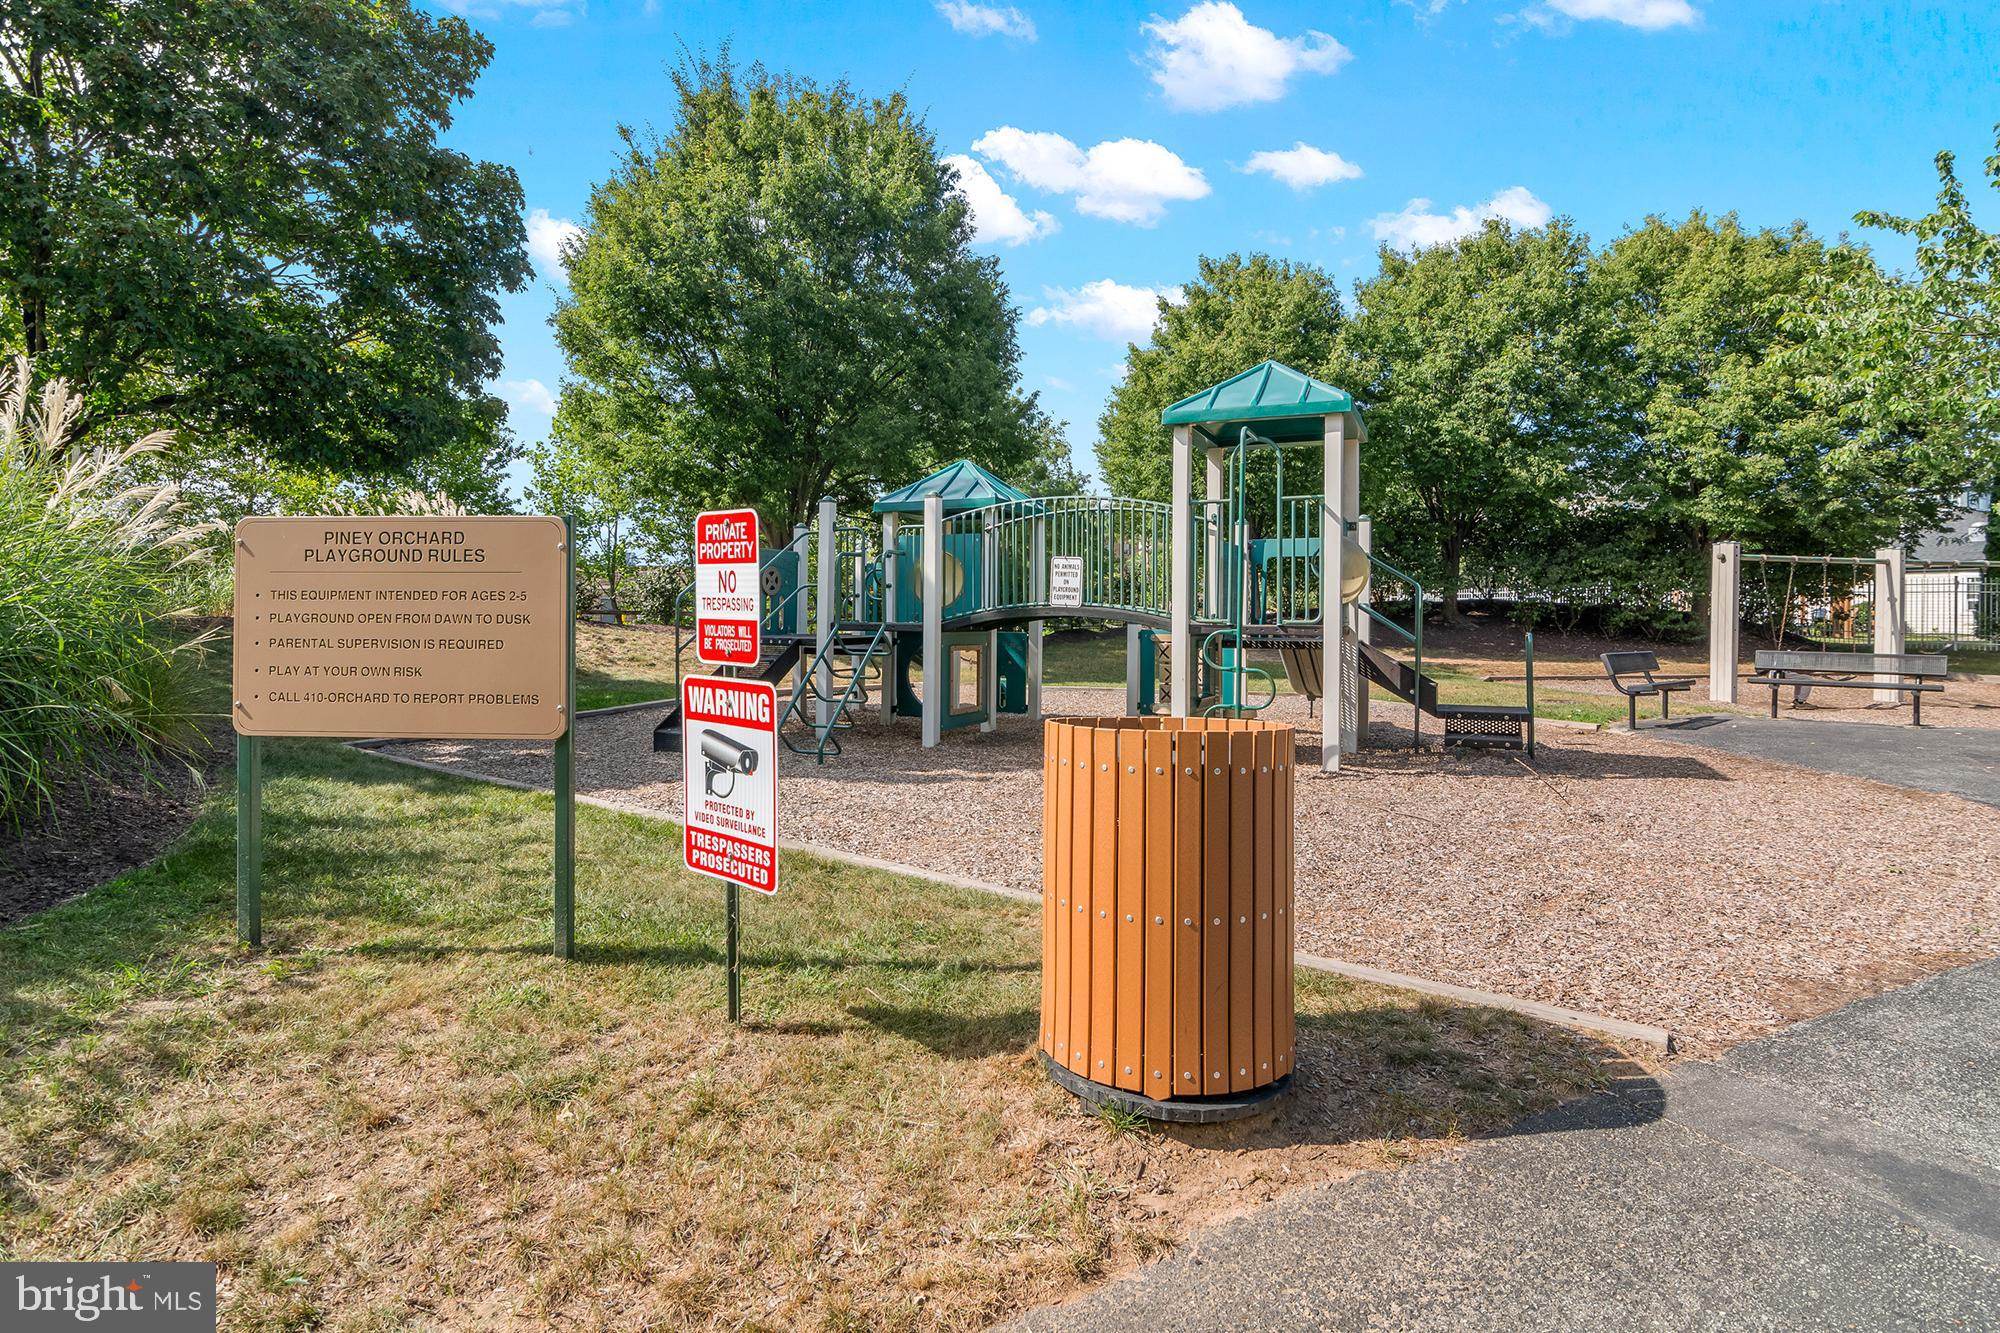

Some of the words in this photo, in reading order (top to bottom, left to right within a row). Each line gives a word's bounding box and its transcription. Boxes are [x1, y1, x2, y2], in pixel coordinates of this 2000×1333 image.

[324, 531, 373, 545] PINEY
[378, 531, 465, 545] ORCHARD
[705, 522, 747, 540] PRIVATE
[304, 549, 422, 563] PLAYGROUND
[428, 549, 485, 563] RULES
[700, 541, 754, 560] PROPERTY
[718, 570, 736, 593] NO
[271, 590, 298, 601] THIS
[301, 590, 372, 601] EQUIPMENT
[375, 590, 438, 601] INTENDED
[442, 591, 467, 601] FOR
[471, 591, 505, 601] AGES
[509, 591, 527, 601] 2-5
[702, 598, 754, 611] TRESPASSING
[269, 613, 355, 624] PLAYGROUND
[357, 613, 392, 624] OPEN
[396, 614, 431, 624] FROM
[434, 614, 472, 624] DAWN
[476, 614, 492, 625] TO
[496, 614, 531, 625] DUSK
[704, 624, 735, 637] VIOLATORS
[738, 626, 752, 638] WILL
[269, 638, 334, 649] PARENTAL
[337, 638, 420, 650] SUPERVISION
[424, 639, 435, 650] IS
[440, 639, 504, 650] REQUIRED
[704, 638, 712, 649] BE
[716, 639, 752, 652] PROSECUTED
[269, 665, 300, 676] PLAY
[304, 666, 319, 676] AT
[323, 666, 358, 677] YOUR
[361, 666, 390, 677] OWN
[394, 666, 422, 677] RISK
[268, 692, 300, 702] CALL
[304, 692, 389, 704] 410-ORCHARD
[393, 693, 410, 704] TO
[413, 693, 465, 704] REPORT
[468, 694, 540, 705] PROBLEMS
[688, 685, 769, 723] WARNING
[705, 800, 743, 818] PROTECTED
[746, 810, 754, 821] BY
[695, 811, 714, 825] VIDEO
[716, 816, 765, 838] SURVEILLANCE
[690, 831, 770, 867] TRESPASSERS
[692, 851, 768, 885] PROSECUTED
